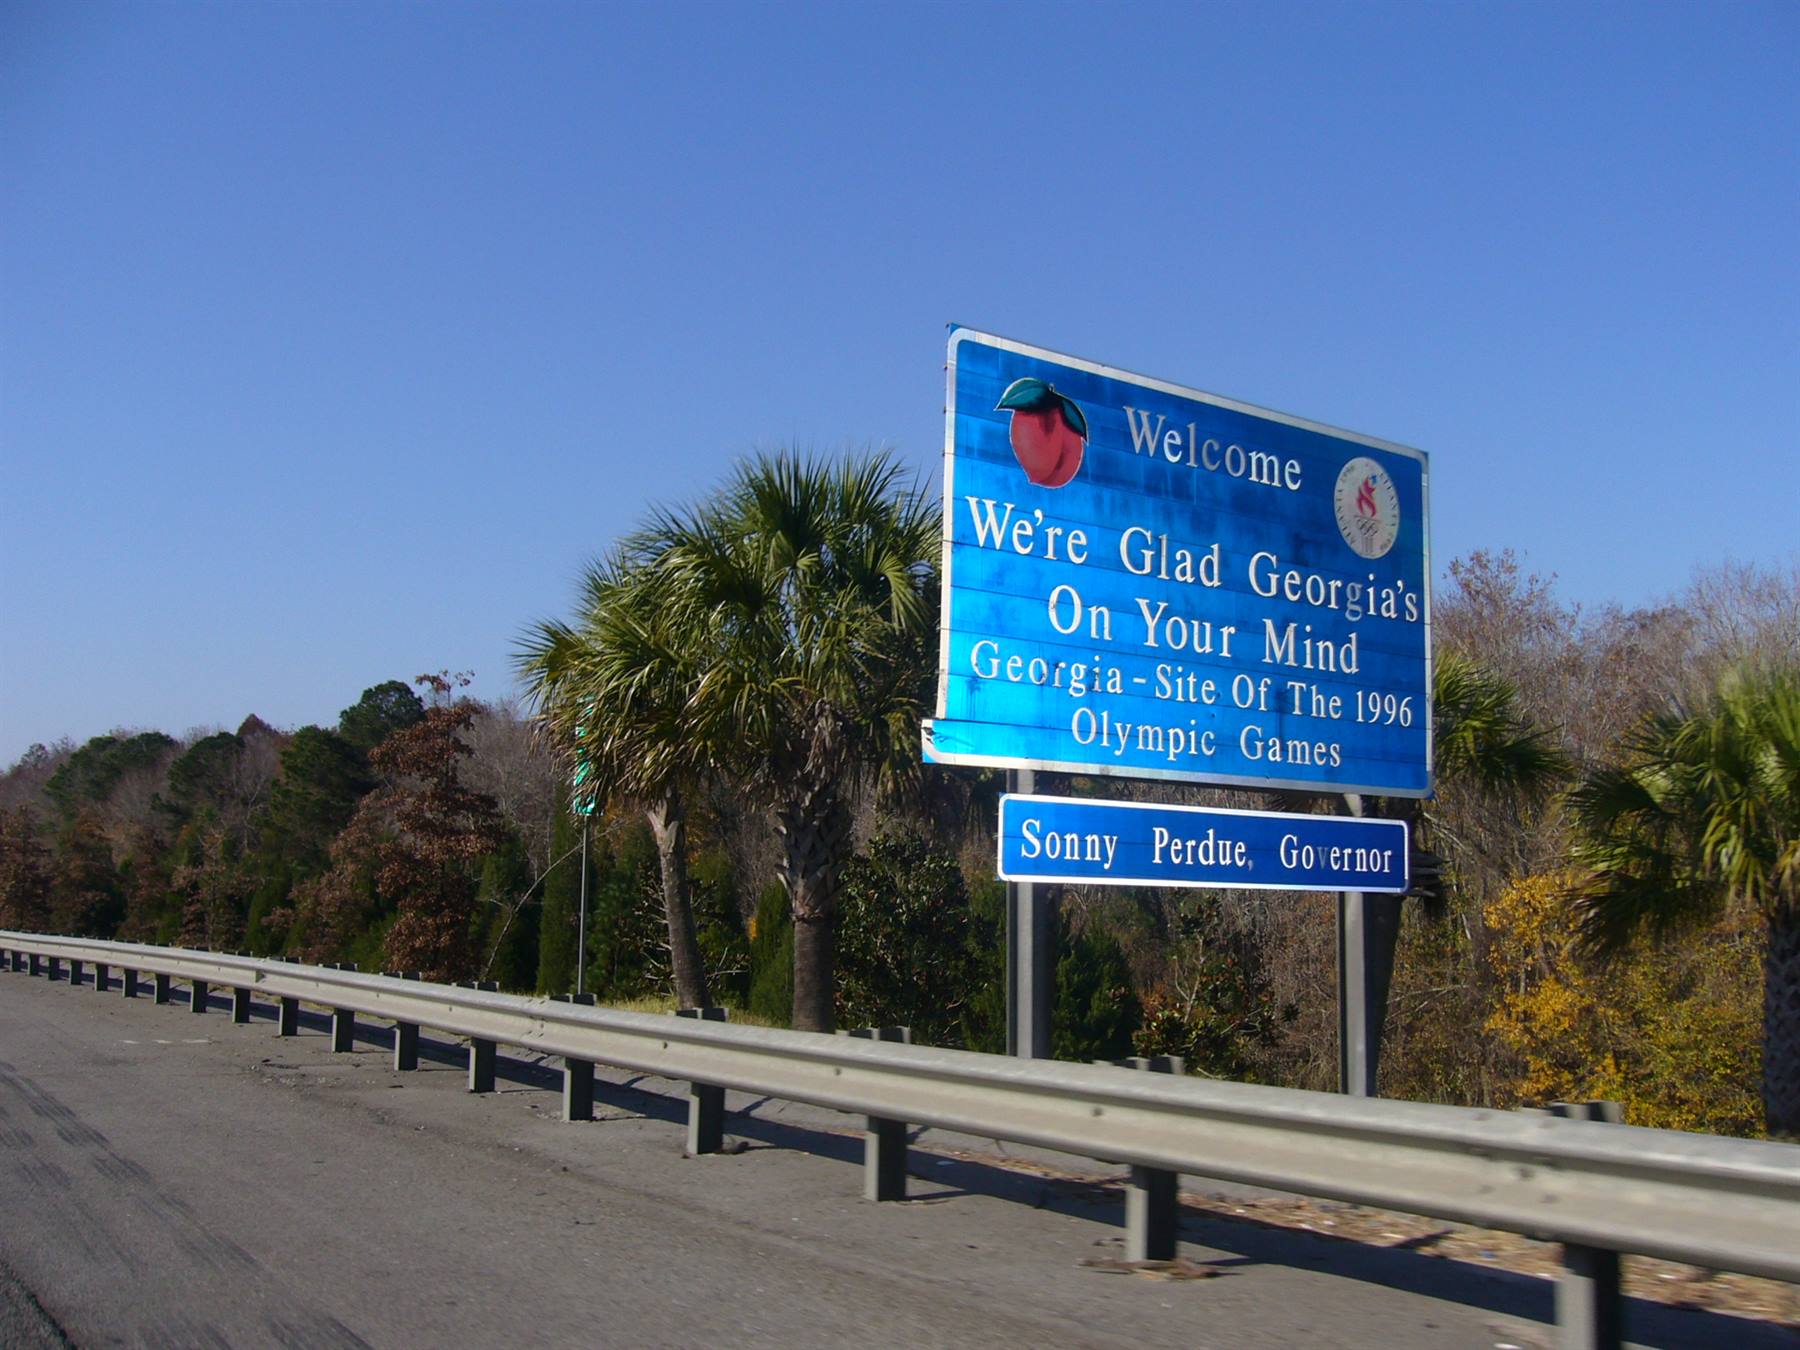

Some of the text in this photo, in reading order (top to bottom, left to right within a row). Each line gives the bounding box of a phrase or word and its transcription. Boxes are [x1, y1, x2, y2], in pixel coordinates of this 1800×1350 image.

[1123, 405, 1301, 491] Welcome
[1119, 526, 1222, 587] Glad
[1047, 584, 1360, 675] On Your Mind
[970, 639, 1123, 698] Georgia
[1155, 664, 1216, 705] Site
[1231, 674, 1272, 711] Of
[1286, 681, 1342, 719] The
[1355, 691, 1413, 728] 1996
[1071, 707, 1342, 767] Olympic Games
[1020, 819, 1118, 869] Sonny
[1279, 834, 1392, 873] Governor
